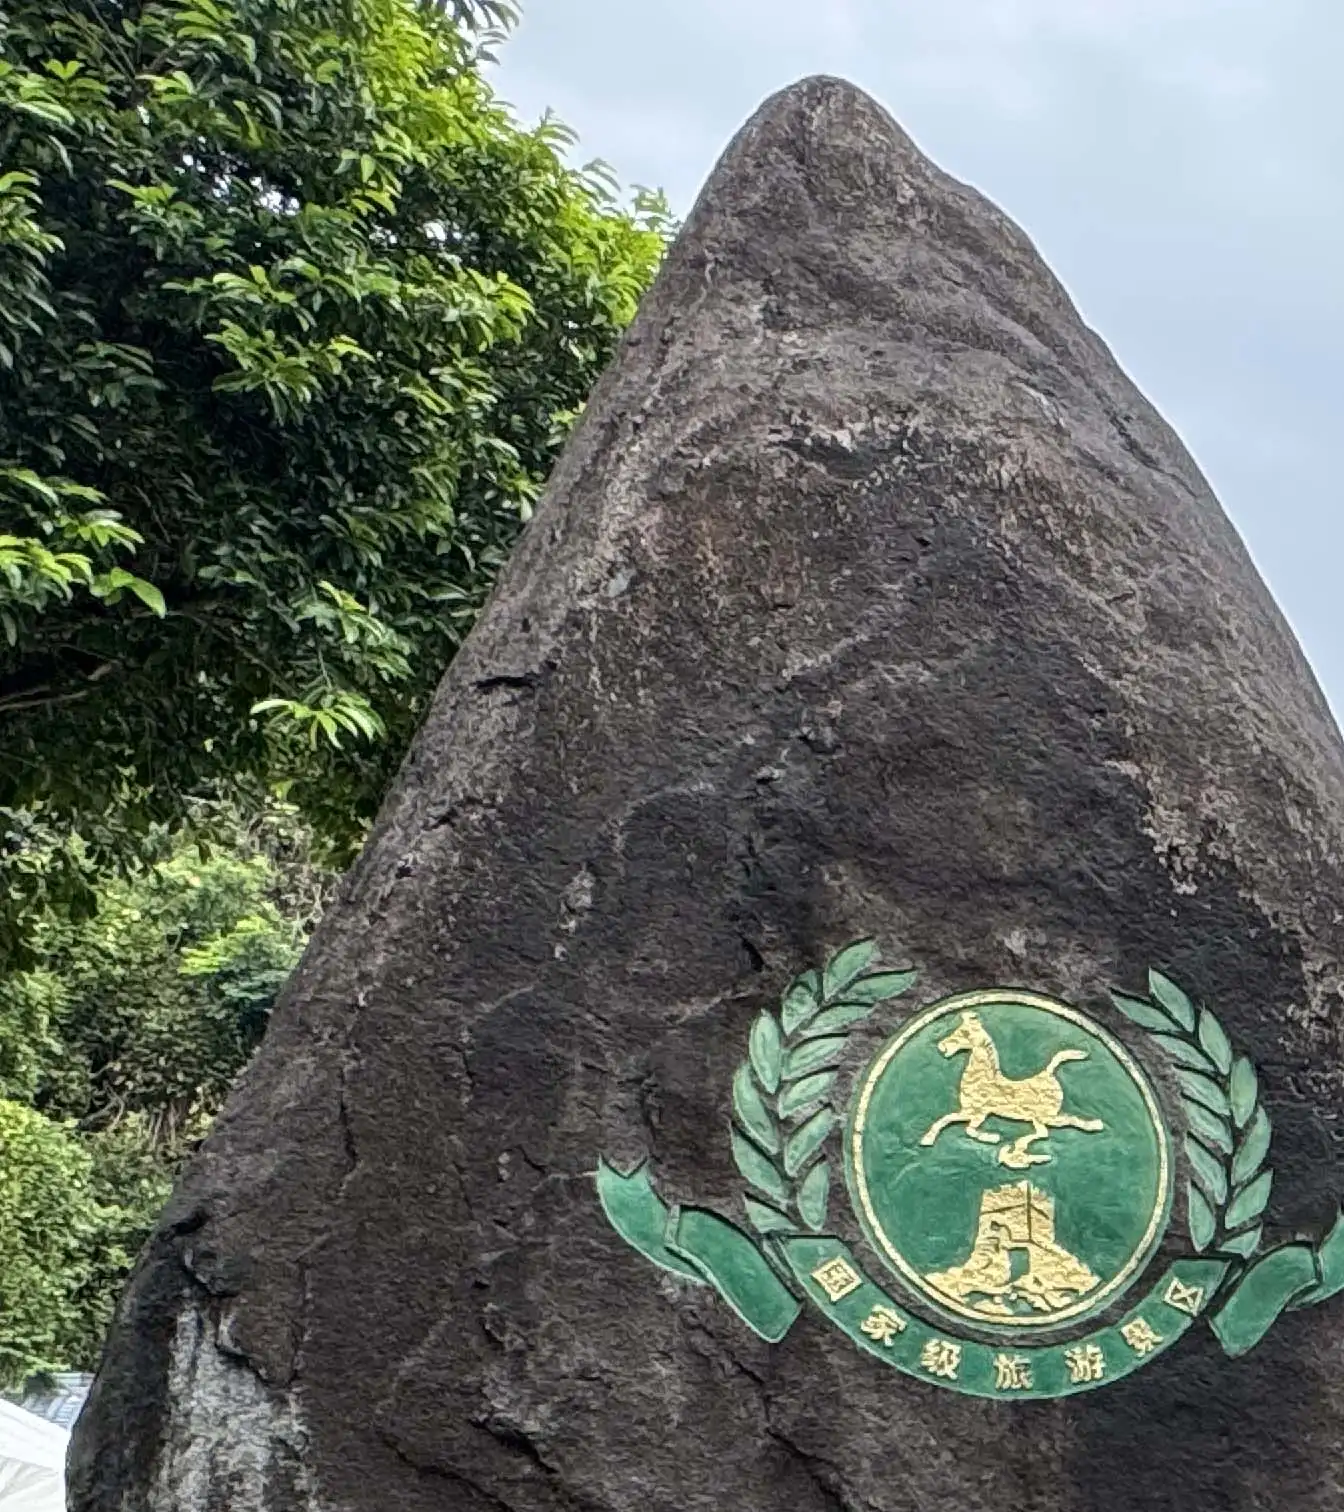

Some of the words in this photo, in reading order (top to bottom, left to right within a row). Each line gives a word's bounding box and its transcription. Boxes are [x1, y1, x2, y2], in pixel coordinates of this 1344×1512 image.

[808, 1255, 1206, 1393] 国家级旅游景区
